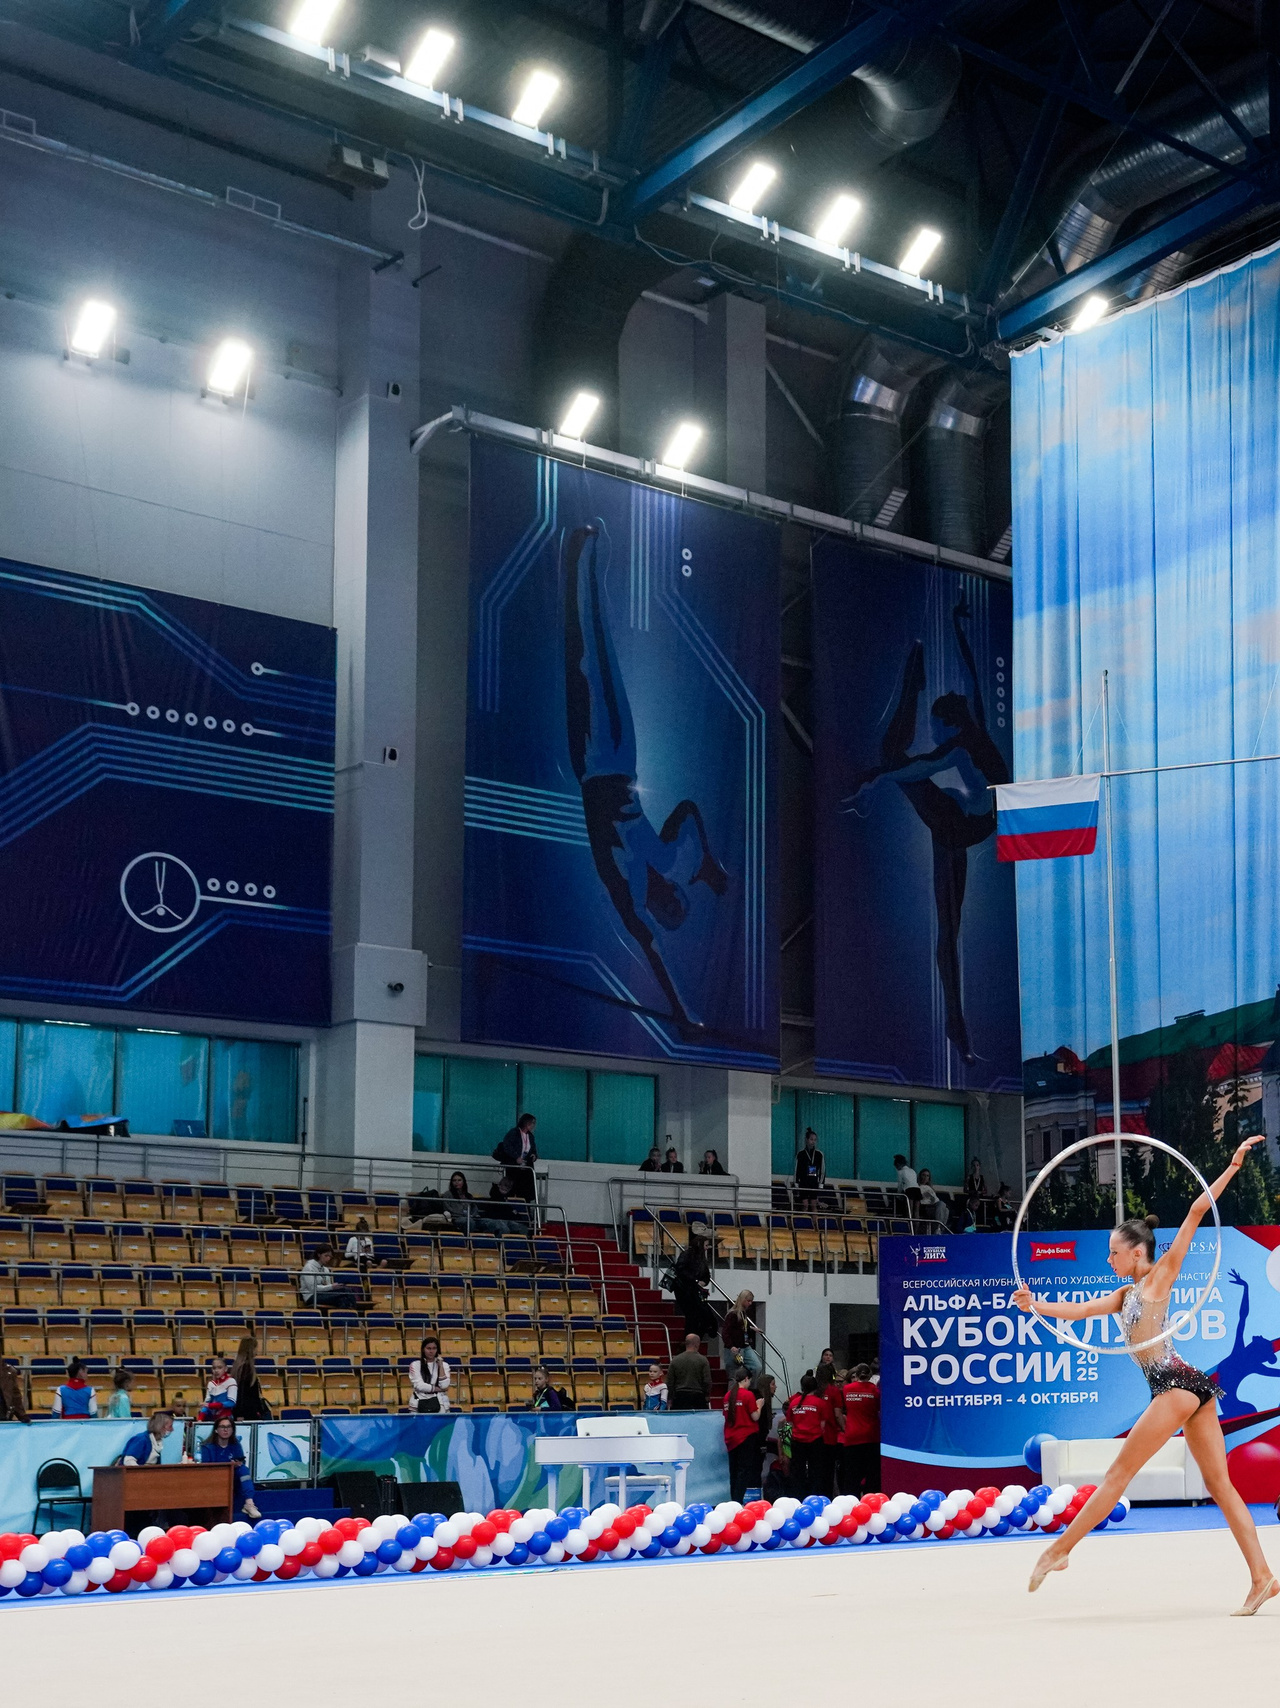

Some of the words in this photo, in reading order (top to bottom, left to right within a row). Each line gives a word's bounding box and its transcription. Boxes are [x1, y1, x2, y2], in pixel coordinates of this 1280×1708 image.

[923, 1252, 946, 1260] ЛИГА
[1035, 1247, 1055, 1255] Альфа
[902, 1278, 980, 1289] ВСЕРОССИЙСКАЯ
[1028, 1276, 1053, 1286] ЛИГА
[1054, 1276, 1068, 1285] ПО
[1070, 1274, 1134, 1285] ХУДОЖЕСТВЕ
[903, 1291, 1050, 1312] АЛЬФА-БАК
[903, 1314, 1042, 1348] КУБОК
[1056, 1309, 1227, 1346] КЛУОВ
[903, 1351, 1072, 1386] РОССИИ
[1076, 1351, 1099, 1365] 20
[1076, 1367, 1099, 1382] 25
[904, 1396, 923, 1408] 30
[926, 1393, 1003, 1407] СЕНТЯБРЯ
[1017, 1393, 1027, 1405] 4
[1031, 1391, 1099, 1405] ОКТЯБРЯ
